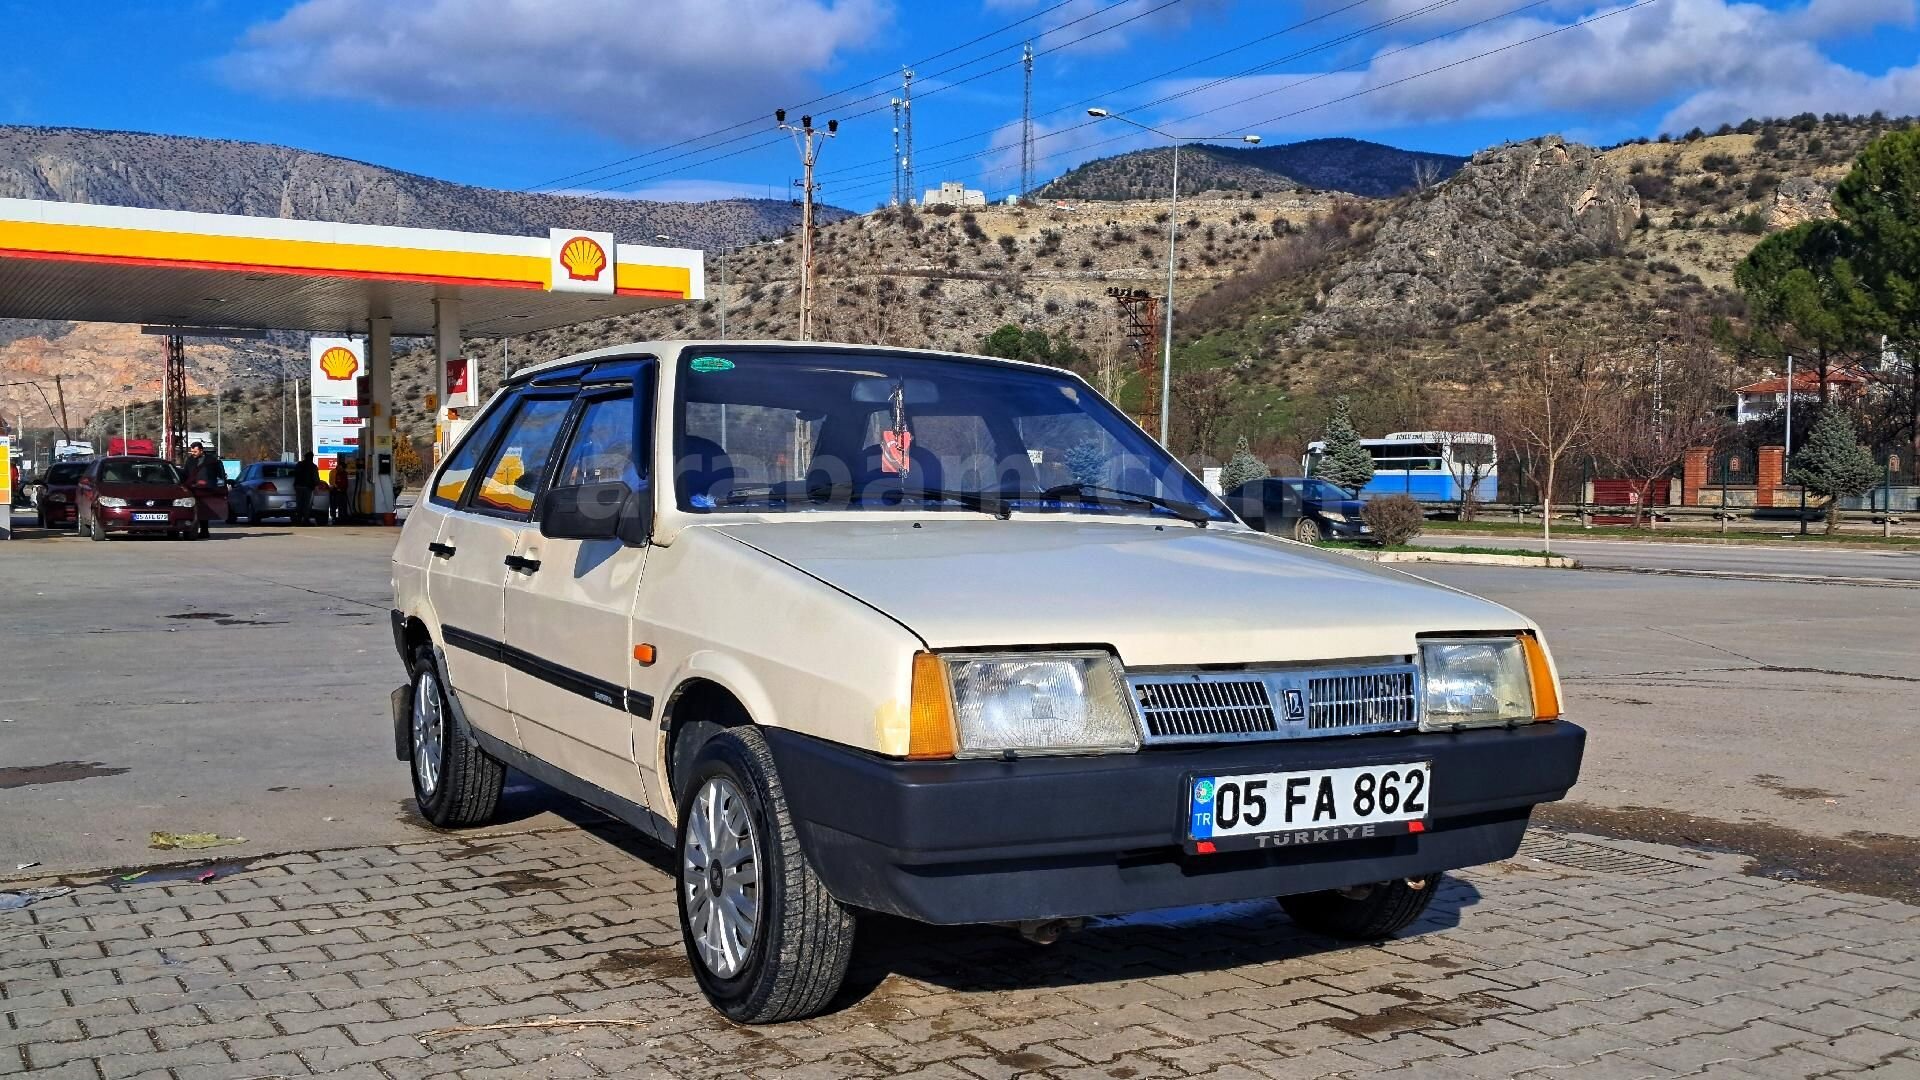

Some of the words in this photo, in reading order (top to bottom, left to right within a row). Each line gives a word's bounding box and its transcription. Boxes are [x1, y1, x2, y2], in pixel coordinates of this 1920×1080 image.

[1195, 813, 1211, 826] TR
[1215, 780, 1268, 830] 05
[1285, 776, 1337, 823] FA
[1353, 768, 1425, 817] 862
